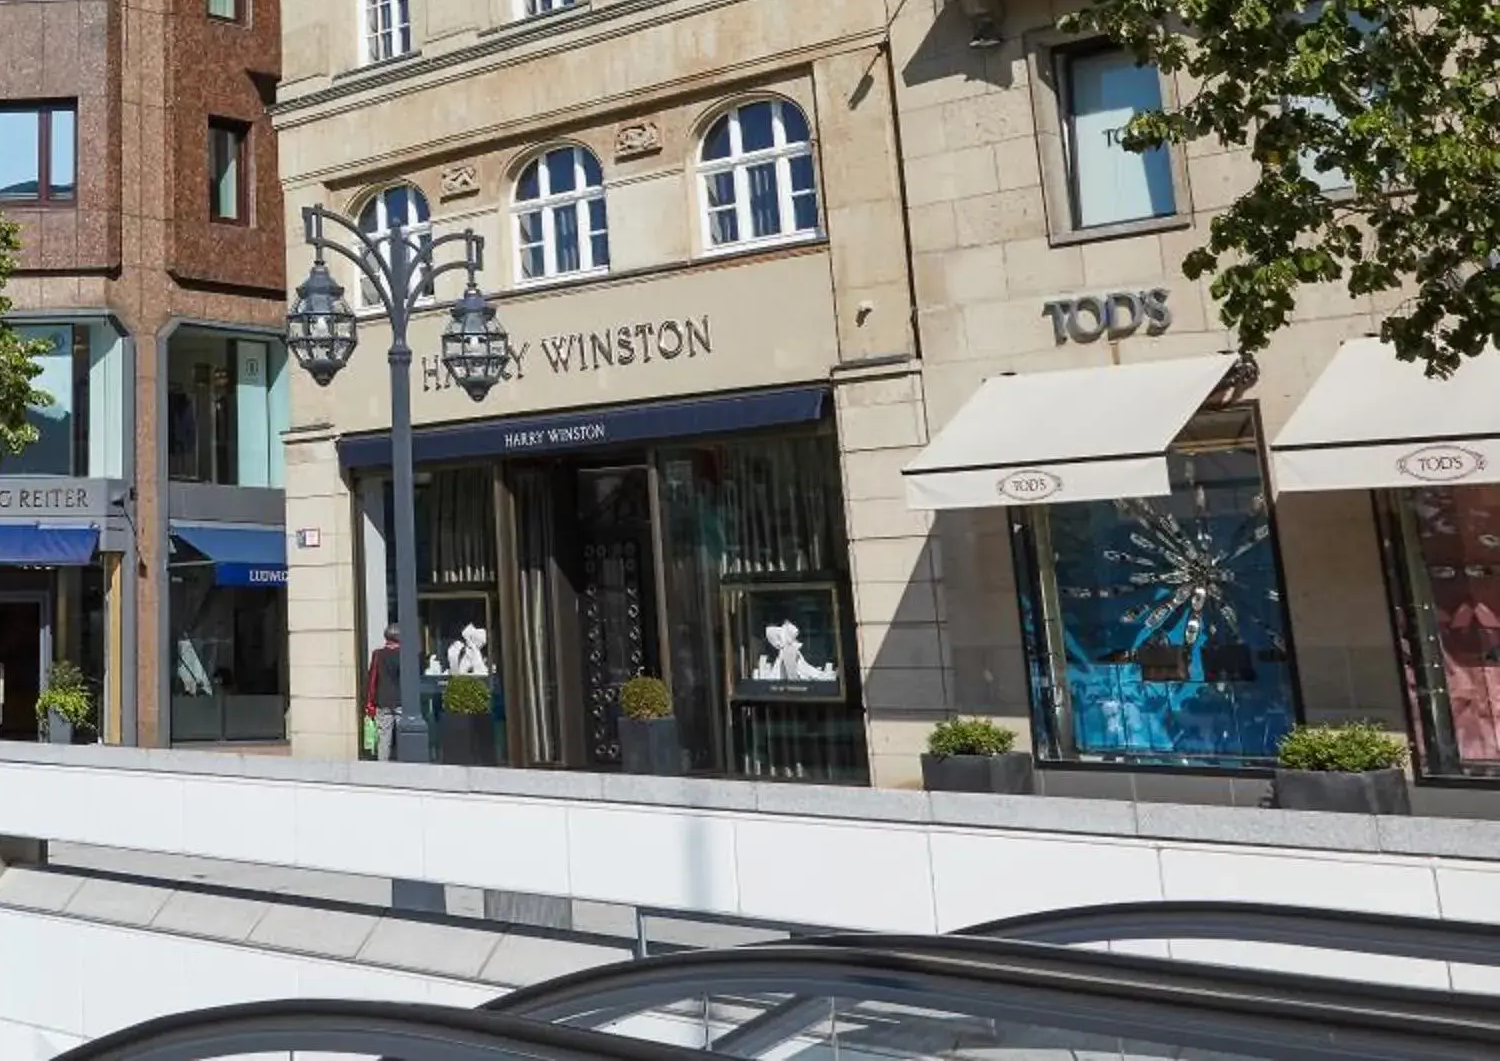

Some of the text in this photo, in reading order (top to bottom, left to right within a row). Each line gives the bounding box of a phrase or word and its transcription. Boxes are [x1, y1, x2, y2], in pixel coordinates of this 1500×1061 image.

[1041, 287, 1173, 347] TOD'S
[540, 315, 712, 374] WINSTON
[504, 423, 605, 448] HARRY WINSTON
[19, 488, 89, 508] REITER
